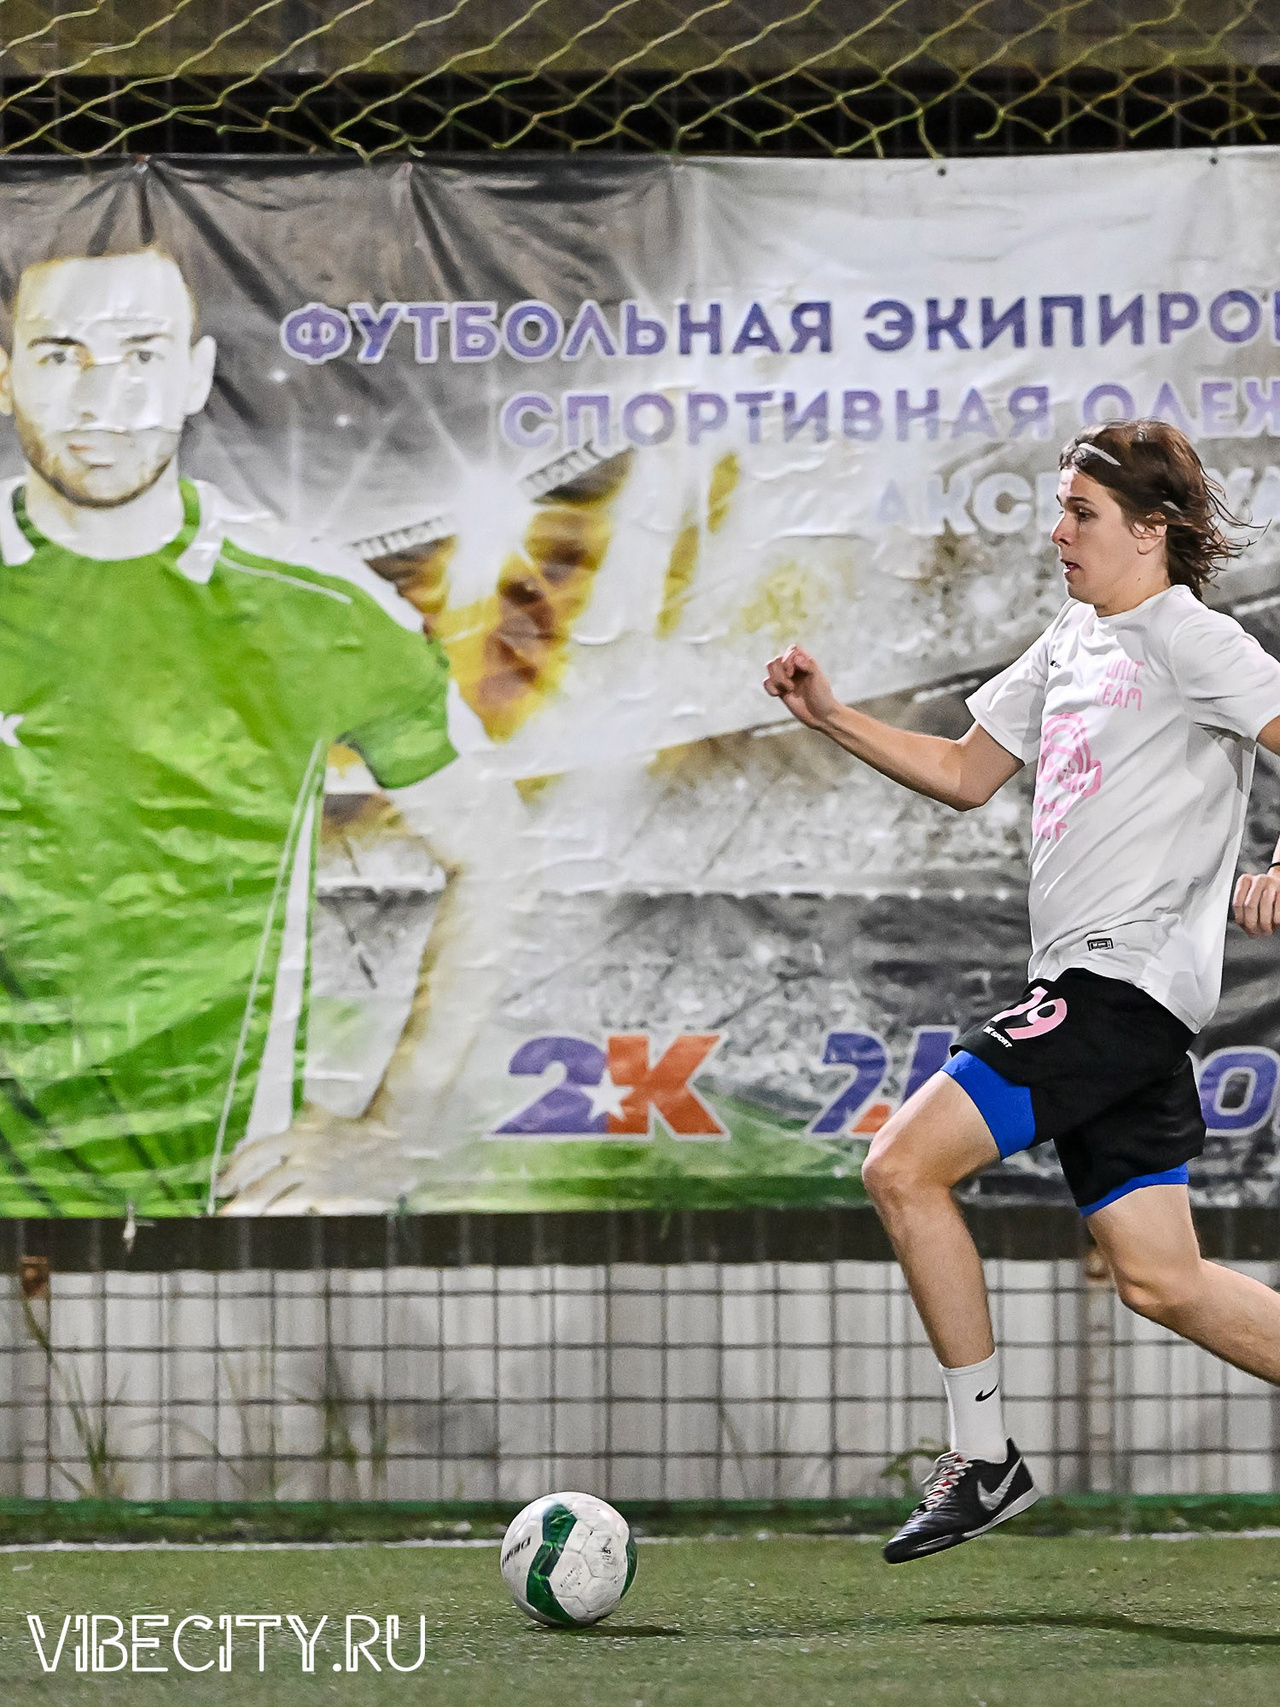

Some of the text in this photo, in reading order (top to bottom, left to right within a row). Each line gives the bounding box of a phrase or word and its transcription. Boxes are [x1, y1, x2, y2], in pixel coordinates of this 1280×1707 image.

[281, 300, 834, 363] ФУТБОЛЬНАЯ
[504, 384, 1050, 448] СПОРТИВНАЯ
[989, 985, 1068, 1040] 19
[486, 1032, 730, 1139] 2K
